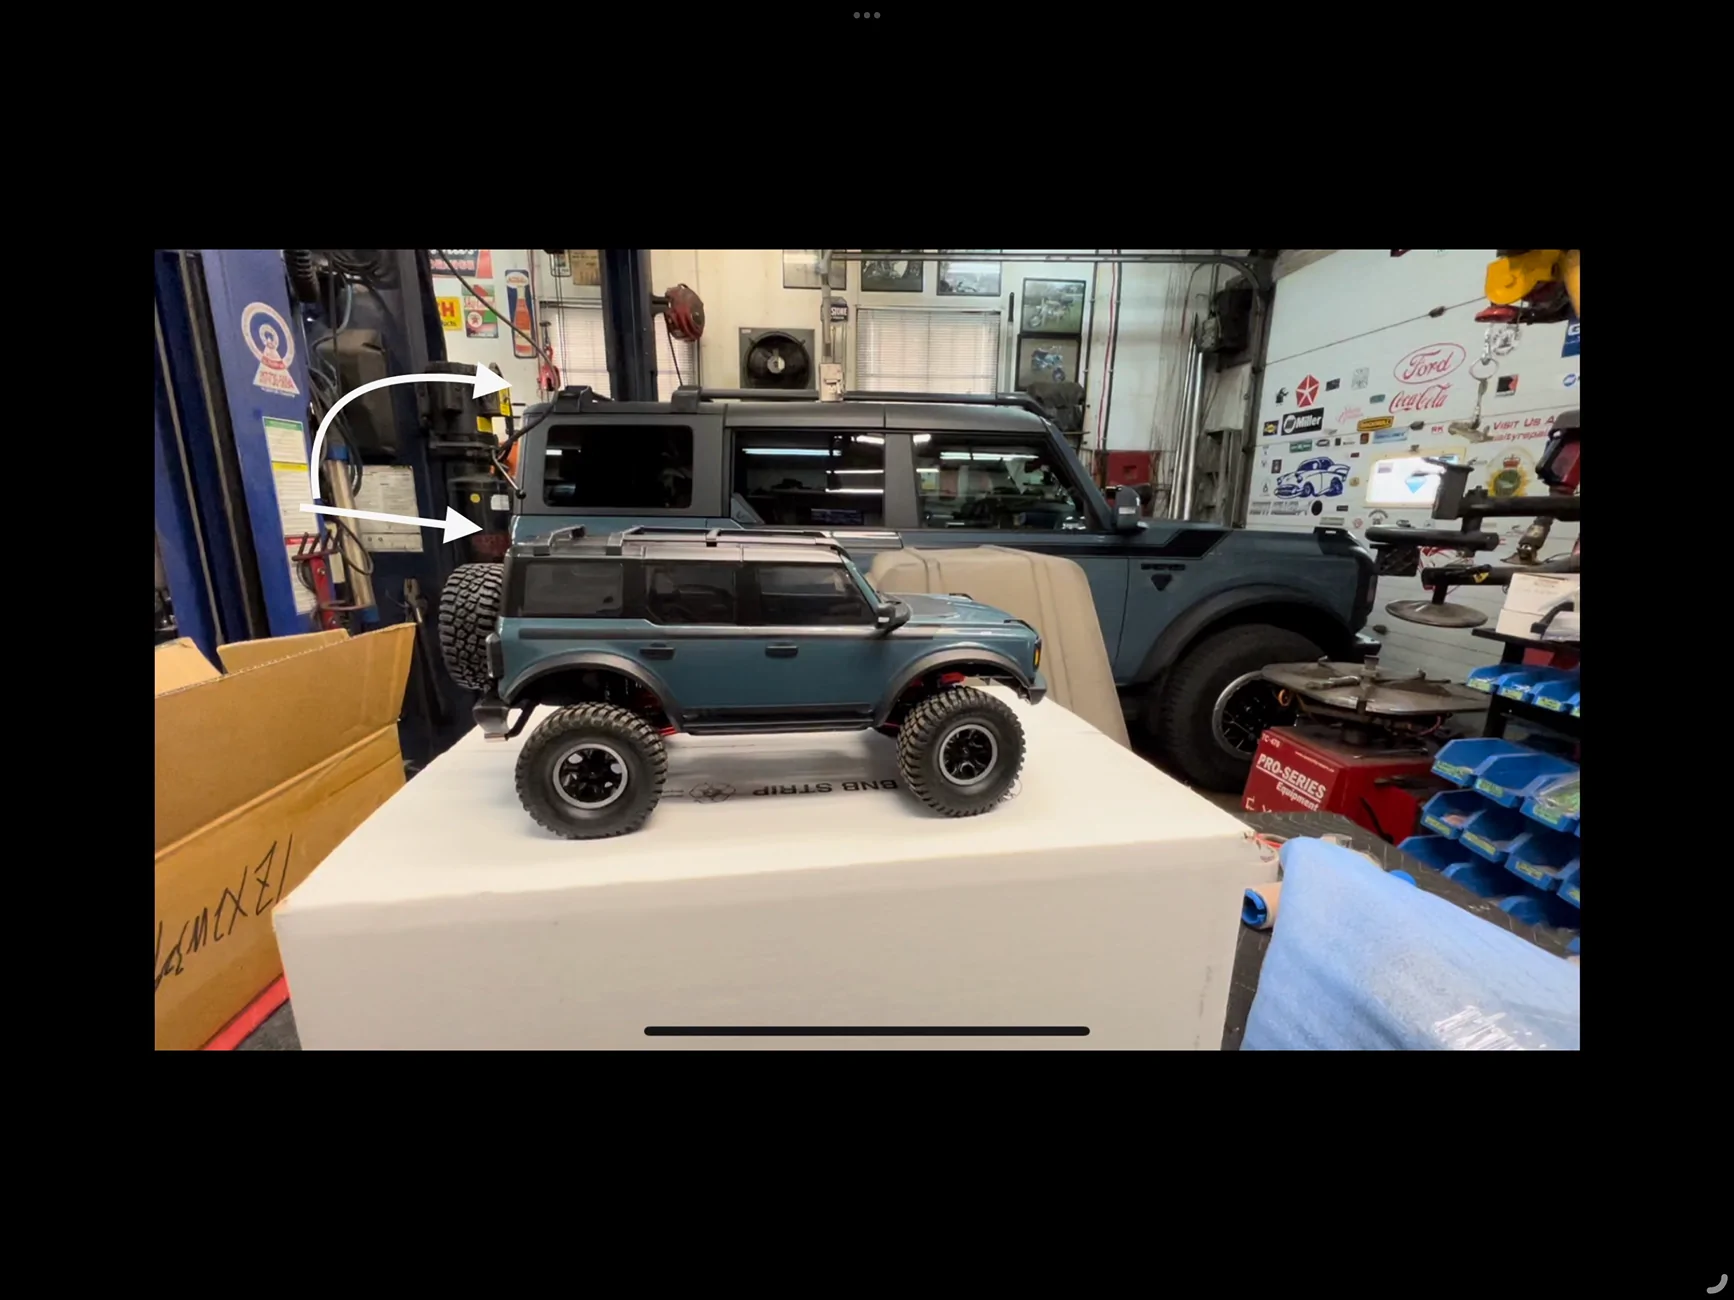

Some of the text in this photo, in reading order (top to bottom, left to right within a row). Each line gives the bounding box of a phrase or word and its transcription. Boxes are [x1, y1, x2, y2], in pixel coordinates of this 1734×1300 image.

[1403, 349, 1454, 380] Ford
[1295, 415, 1323, 429] Miller
[1523, 417, 1541, 428] US
[752, 779, 899, 796] BNB STRIP
[1257, 753, 1327, 799] PRO-SERIES
[1275, 781, 1319, 811] Equipment
